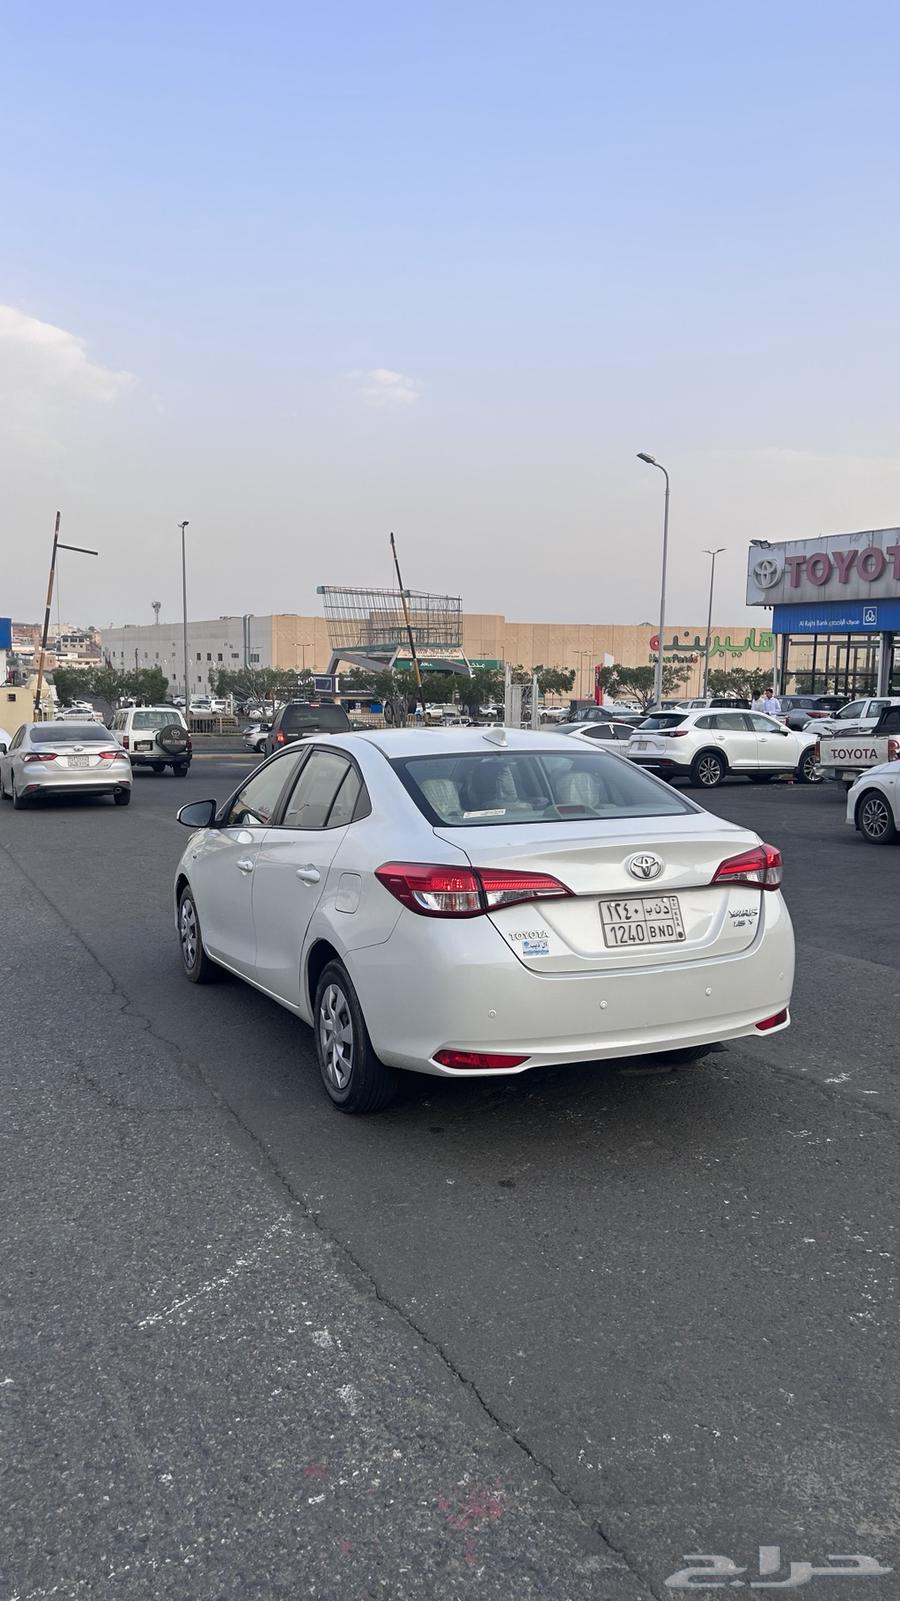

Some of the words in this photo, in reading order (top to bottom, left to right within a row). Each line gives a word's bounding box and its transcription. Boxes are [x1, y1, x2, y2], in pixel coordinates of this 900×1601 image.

[831, 749, 878, 760] TOYOTA
[508, 930, 550, 941] TOYOTA
[610, 924, 645, 944] 1240
[649, 924, 674, 938] BND
